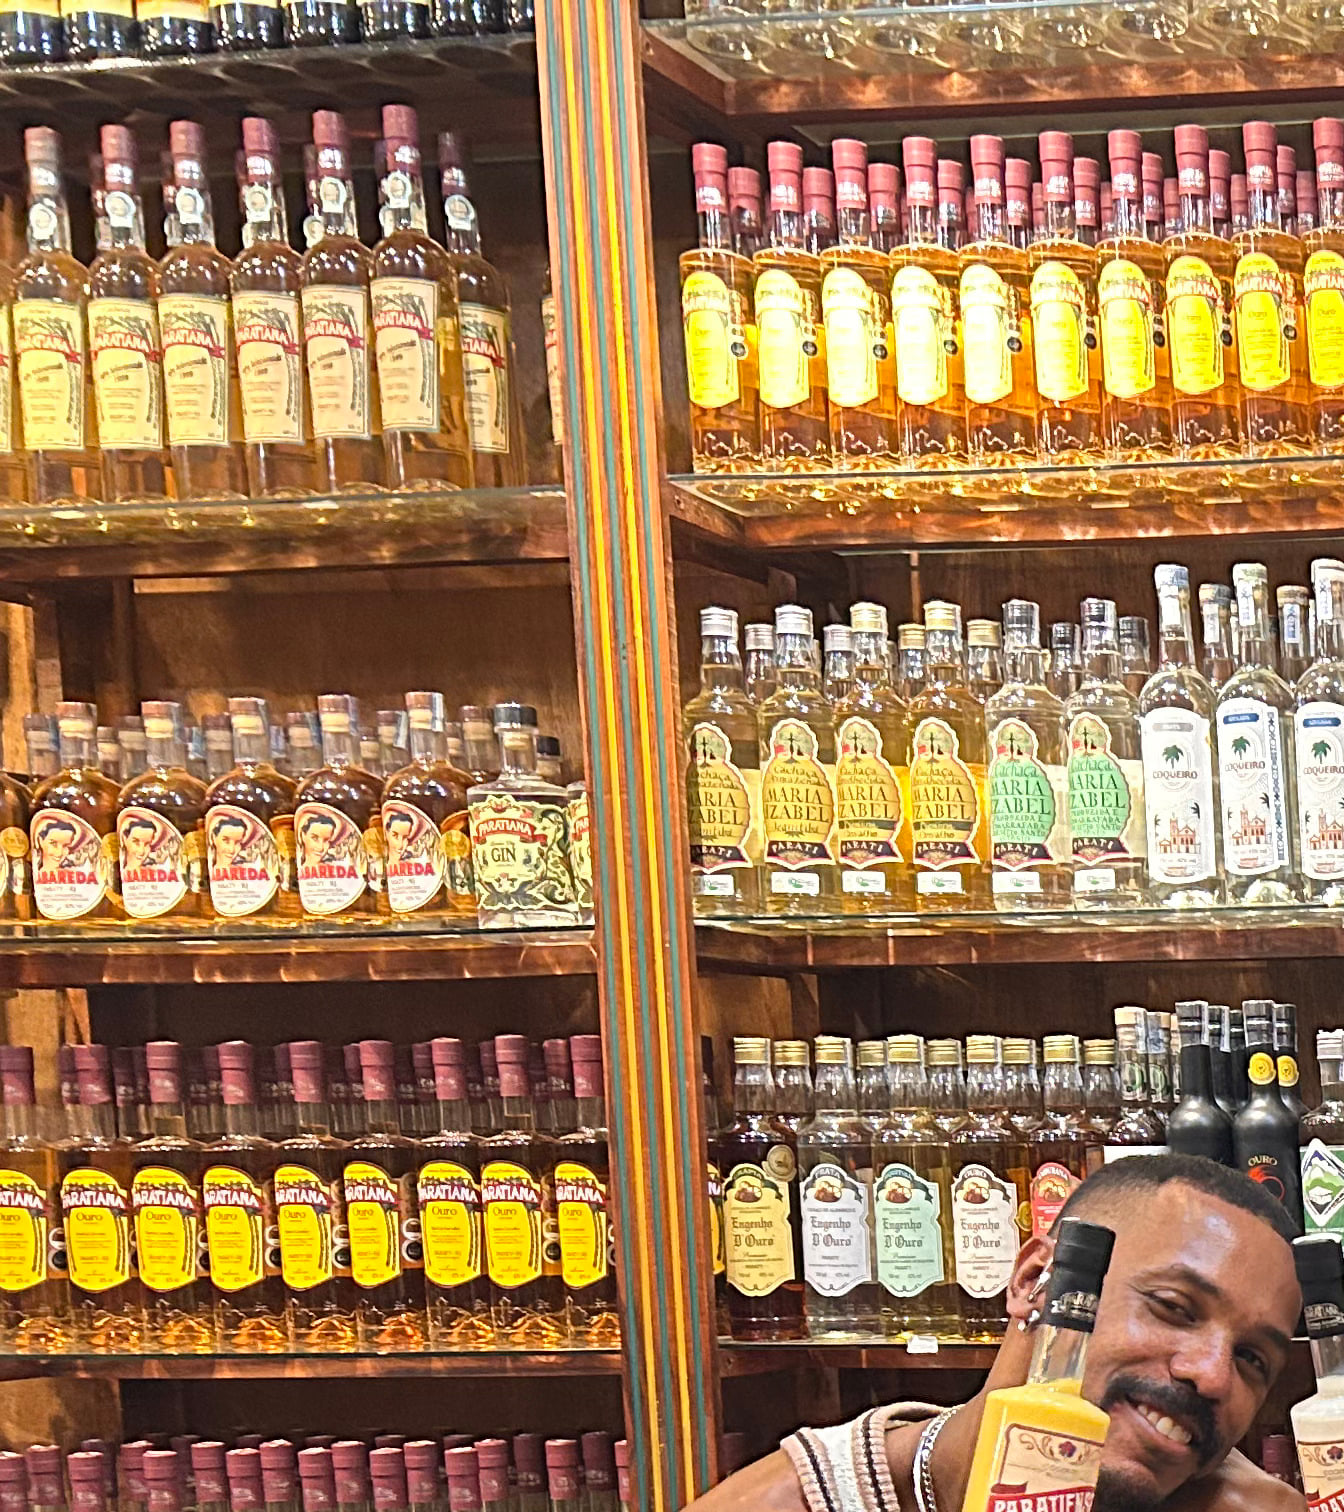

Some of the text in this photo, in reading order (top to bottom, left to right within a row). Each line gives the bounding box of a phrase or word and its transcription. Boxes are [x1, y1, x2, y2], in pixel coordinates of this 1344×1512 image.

[1225, 759, 1266, 772] COQUEIRO
[1303, 765, 1344, 776] COQUEIRO
[1153, 769, 1198, 780] COQUEIRO
[765, 804, 829, 822] IZABEL
[477, 817, 534, 837] PARATIANA
[491, 844, 518, 865] GIN
[1248, 1156, 1278, 1166] OURO
[75, 1211, 102, 1222] Ouro
[145, 1210, 172, 1222] Ouro
[431, 1206, 458, 1218] Ouro
[492, 1206, 518, 1218] Ouro
